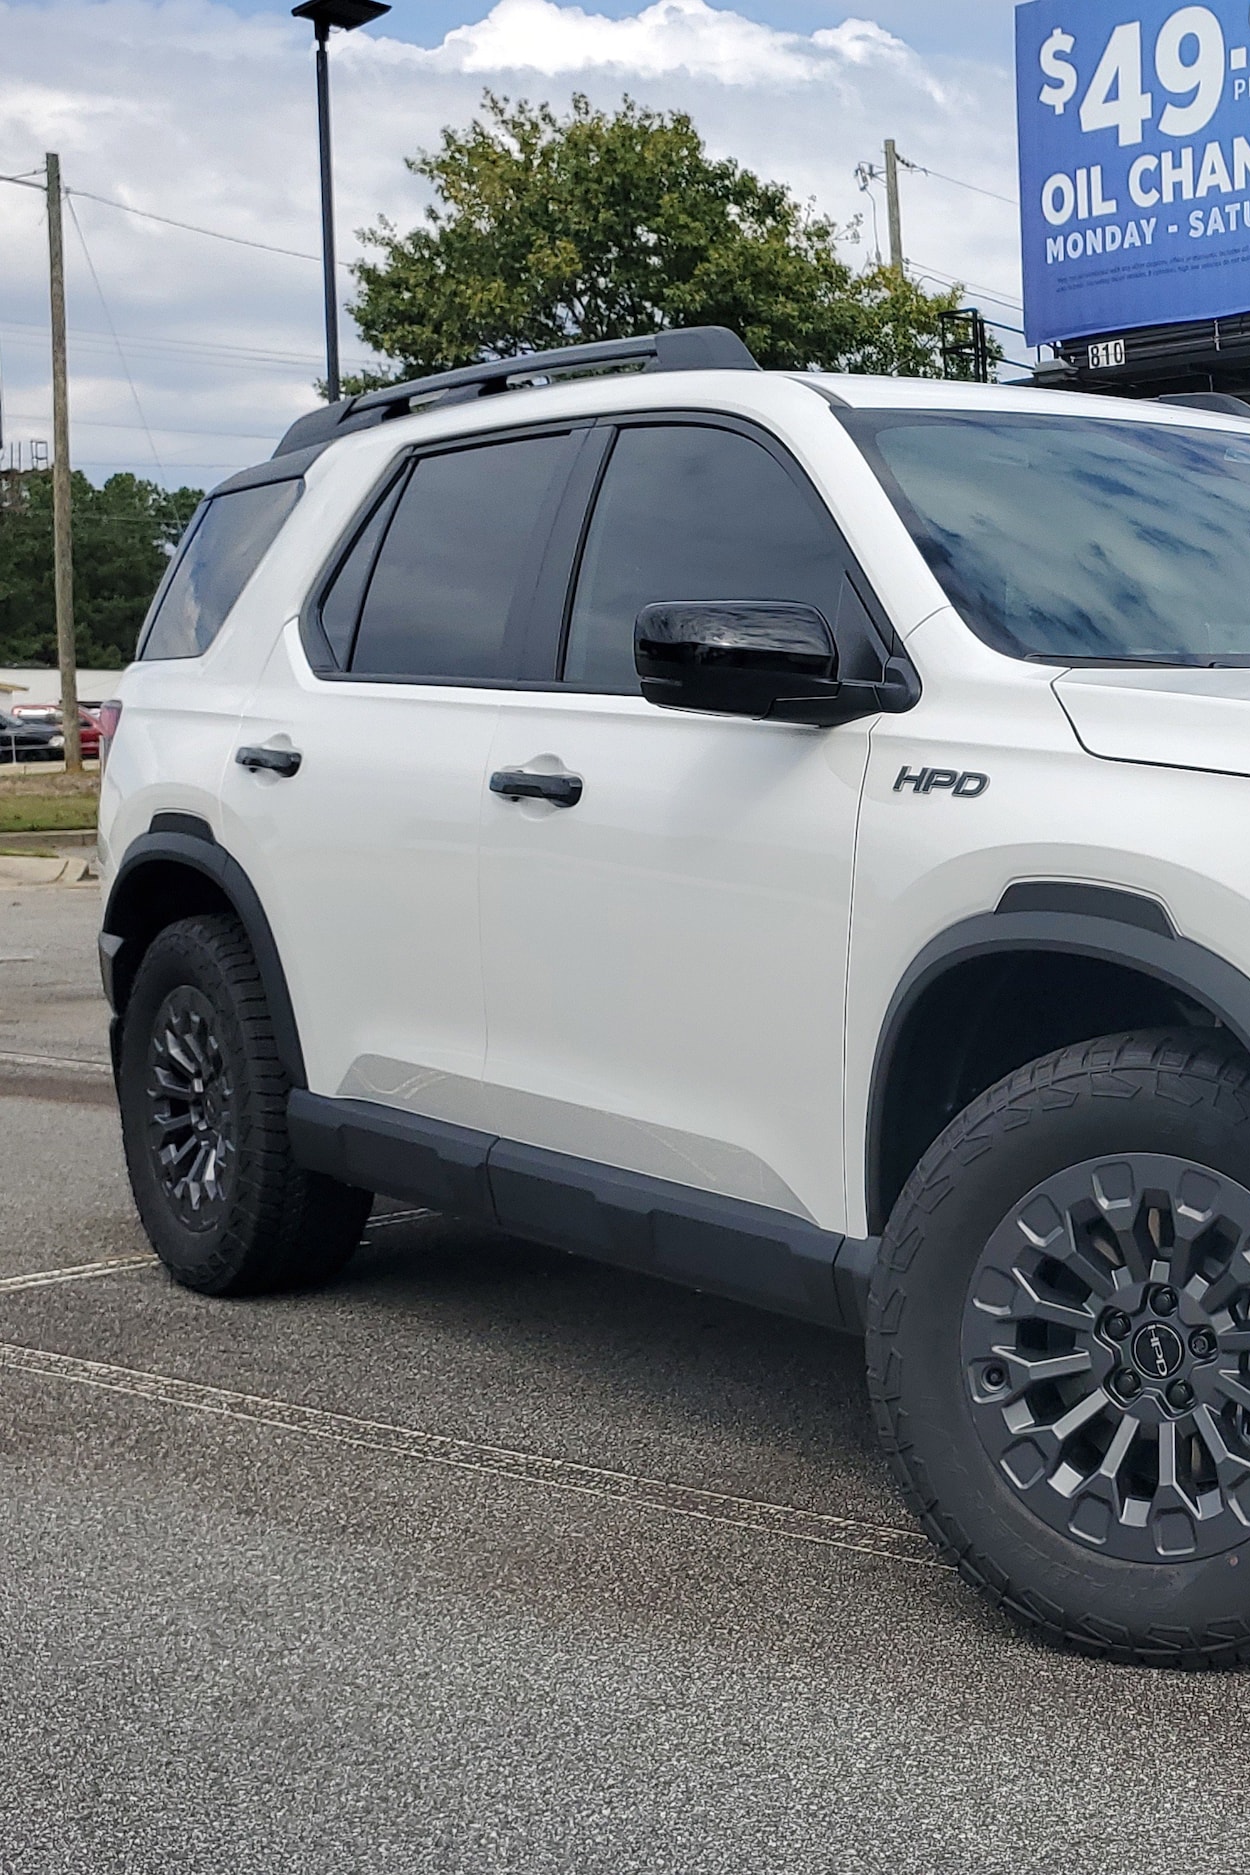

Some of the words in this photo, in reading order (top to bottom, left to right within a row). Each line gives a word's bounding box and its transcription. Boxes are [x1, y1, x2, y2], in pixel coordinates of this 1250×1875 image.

[1041, 164, 1118, 226] OIL
[1046, 217, 1158, 264] MONDAY
[1090, 342, 1123, 367] 810
[893, 765, 991, 798] HPD
[1147, 1324, 1168, 1376] HPD
